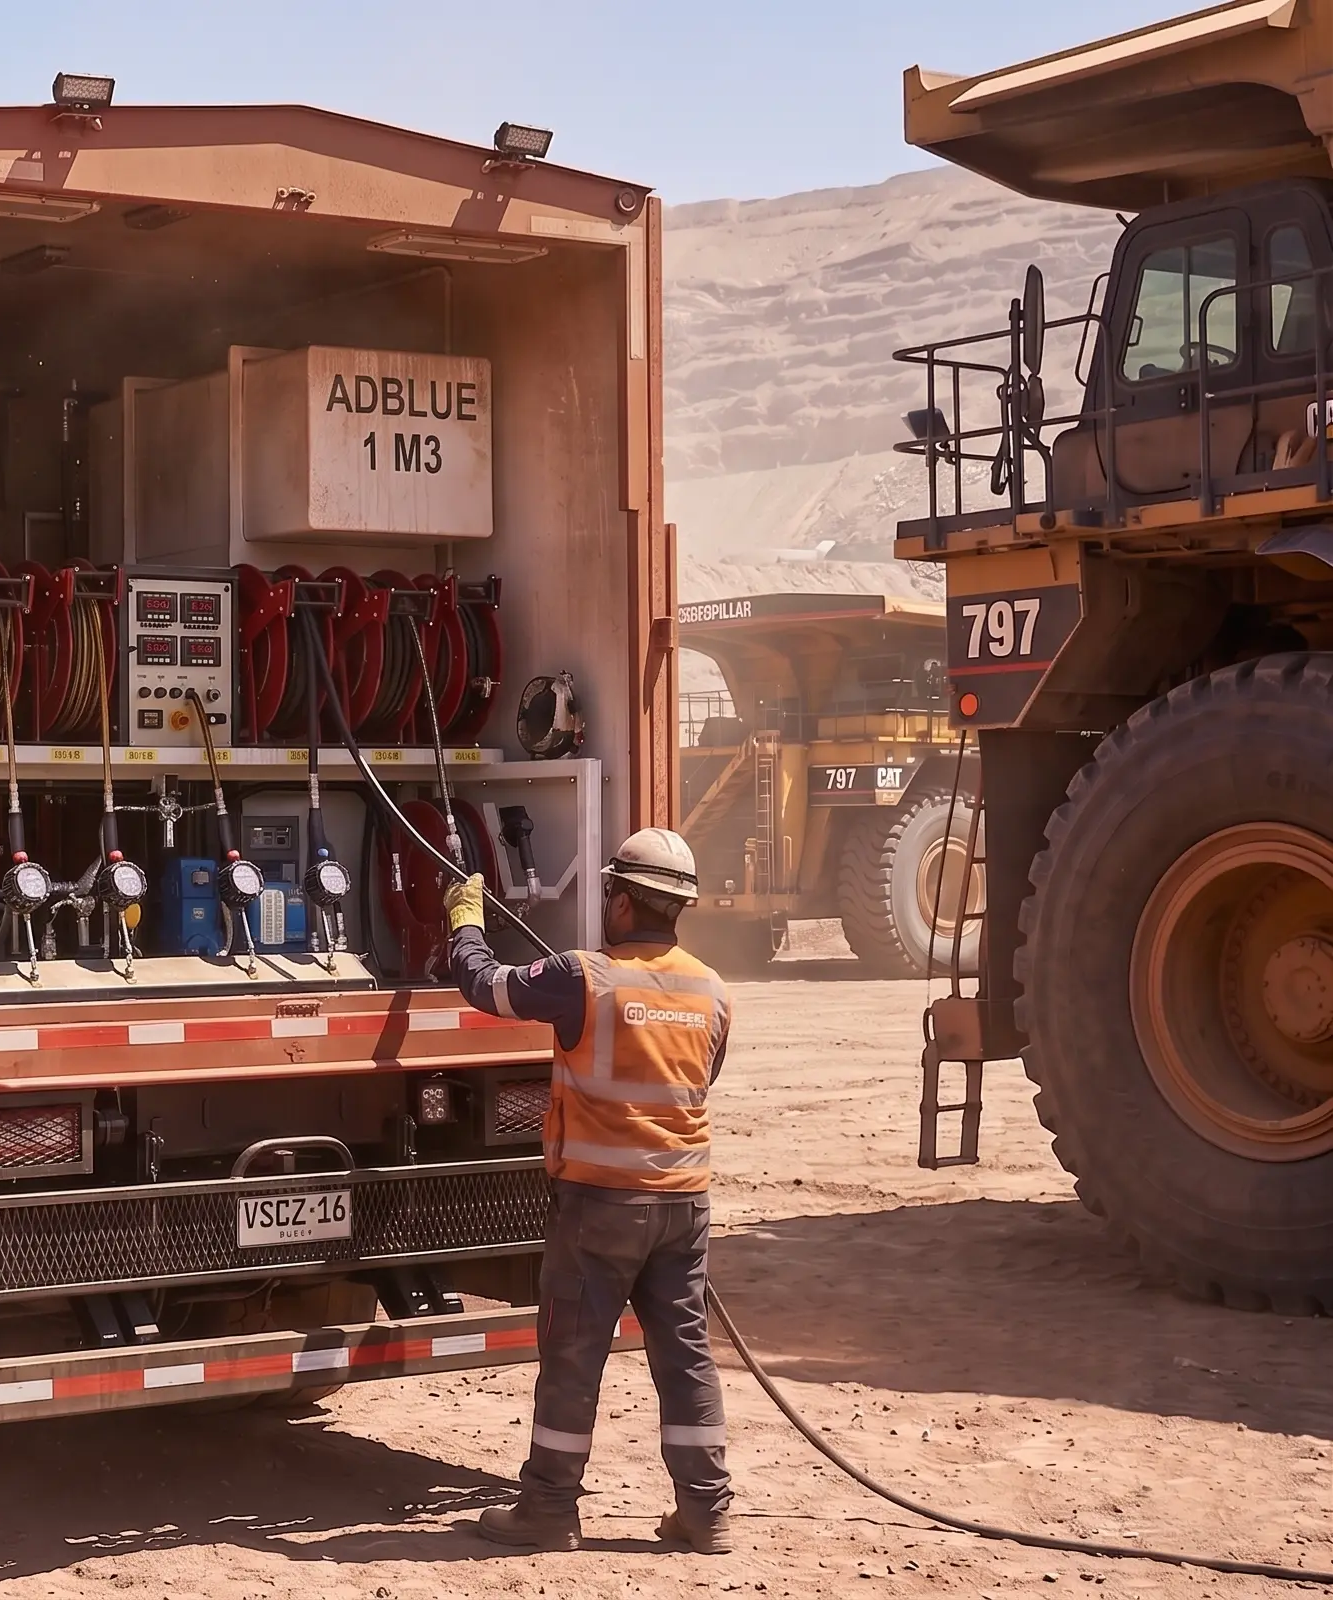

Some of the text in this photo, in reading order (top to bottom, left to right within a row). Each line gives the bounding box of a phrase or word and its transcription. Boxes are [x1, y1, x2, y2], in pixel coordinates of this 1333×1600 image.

[325, 373, 477, 421] ADBLUE
[363, 431, 442, 474] 1 M3
[962, 598, 1041, 659] 797
[825, 767, 903, 790] 797 CAT
